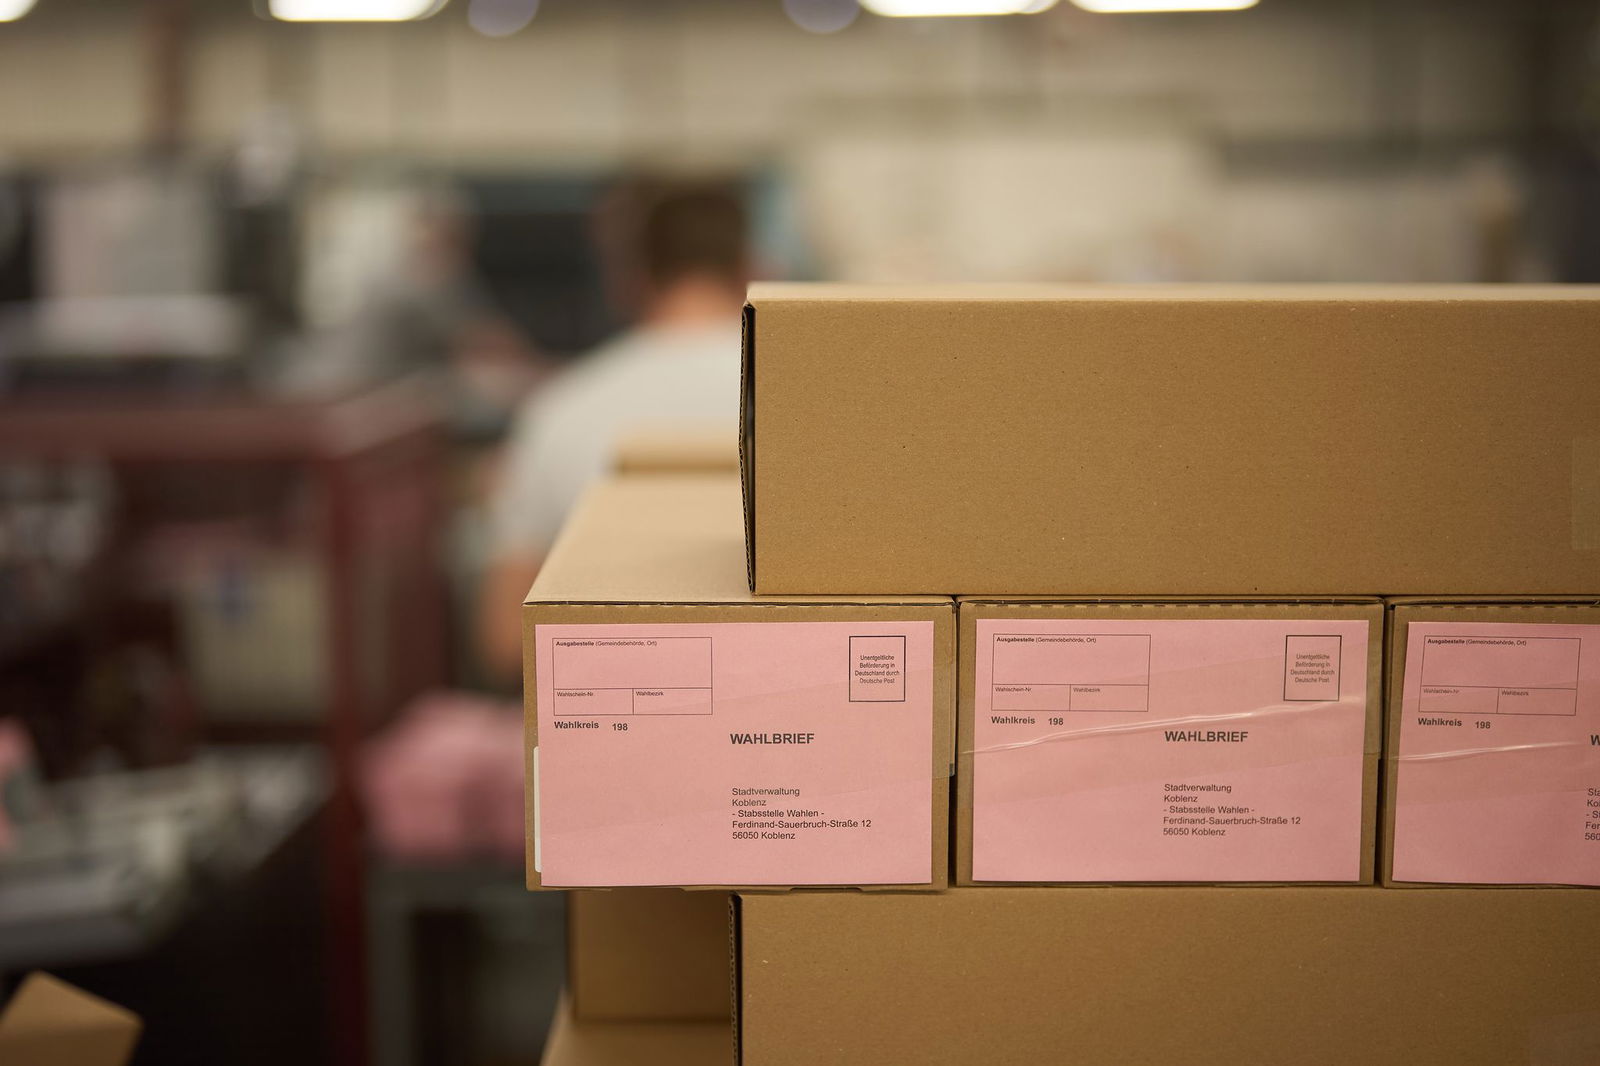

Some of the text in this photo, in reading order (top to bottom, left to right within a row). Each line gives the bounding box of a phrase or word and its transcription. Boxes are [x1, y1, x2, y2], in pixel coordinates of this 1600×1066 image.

[554, 721, 599, 729] Wahlkreis
[1418, 718, 1491, 729] Wahlkreis 198
[730, 733, 814, 744] WAHLBRIEF
[1164, 731, 1248, 742] WAHLBRIEF
[732, 787, 800, 797] Stadtverwaltung
[1164, 784, 1232, 793] Stadtverwaltung
[732, 820, 858, 829] Ferdinand-Sauerbruch-Straße
[1163, 816, 1288, 825] Ferdinand-Sauerbruch-Straße
[761, 832, 795, 840] Koblenz
[1163, 828, 1189, 836] 56050
